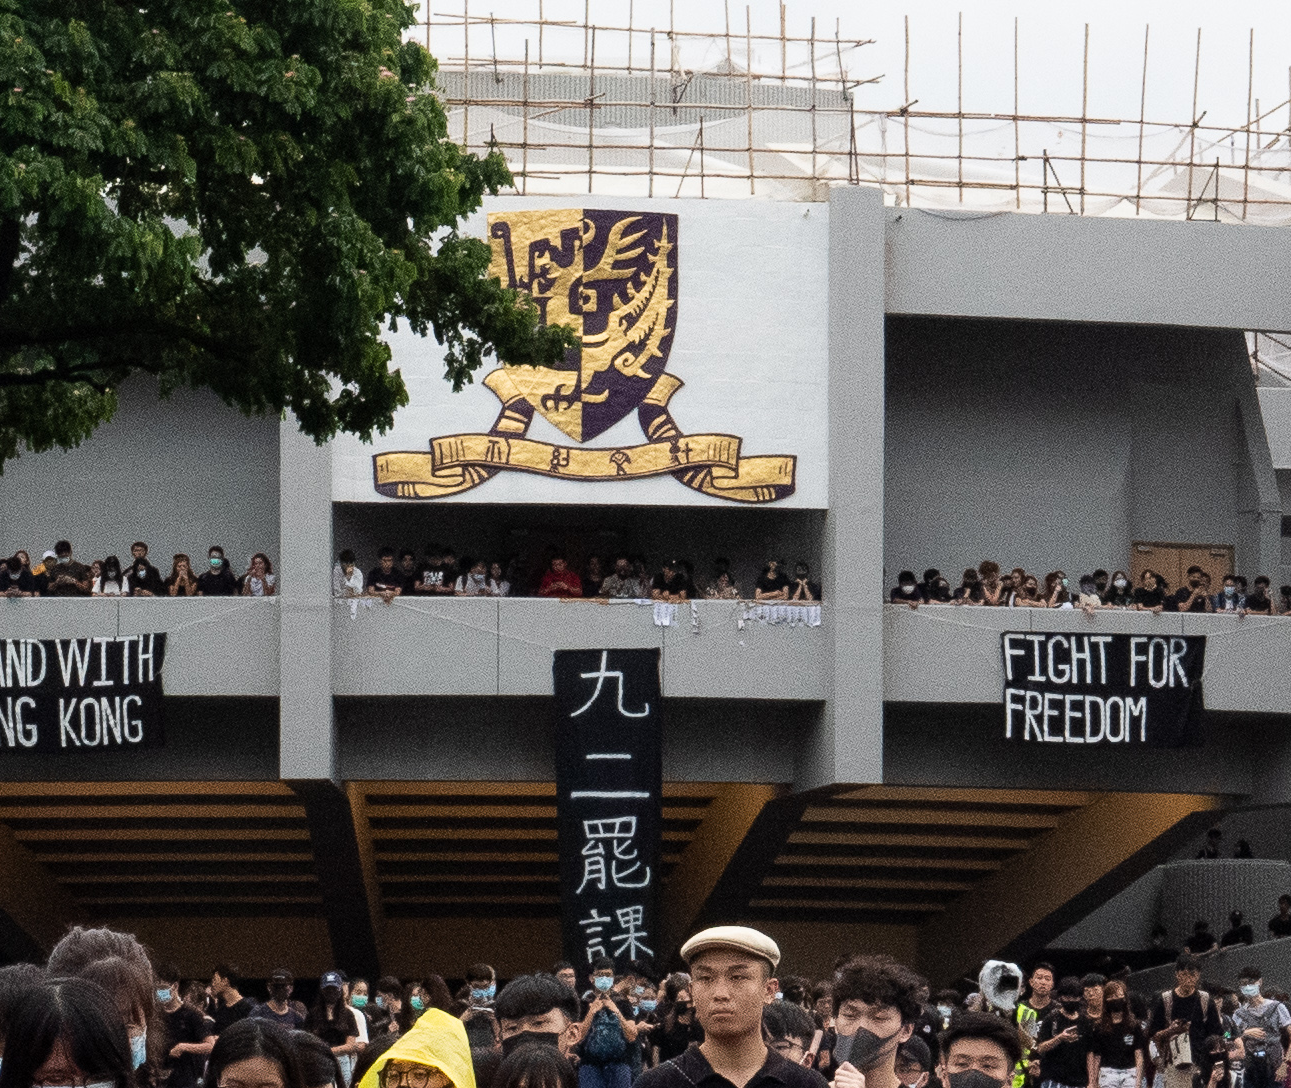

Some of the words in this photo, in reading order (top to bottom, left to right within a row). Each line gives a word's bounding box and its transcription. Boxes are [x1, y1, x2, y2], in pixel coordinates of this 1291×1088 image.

[55, 633, 155, 688] WITH
[1003, 633, 1112, 685] FIGHT
[1129, 636, 1189, 688] FOR
[59, 695, 144, 748] KONG
[1005, 688, 1147, 743] FREEDOM
[569, 650, 654, 964] 九二罷課
